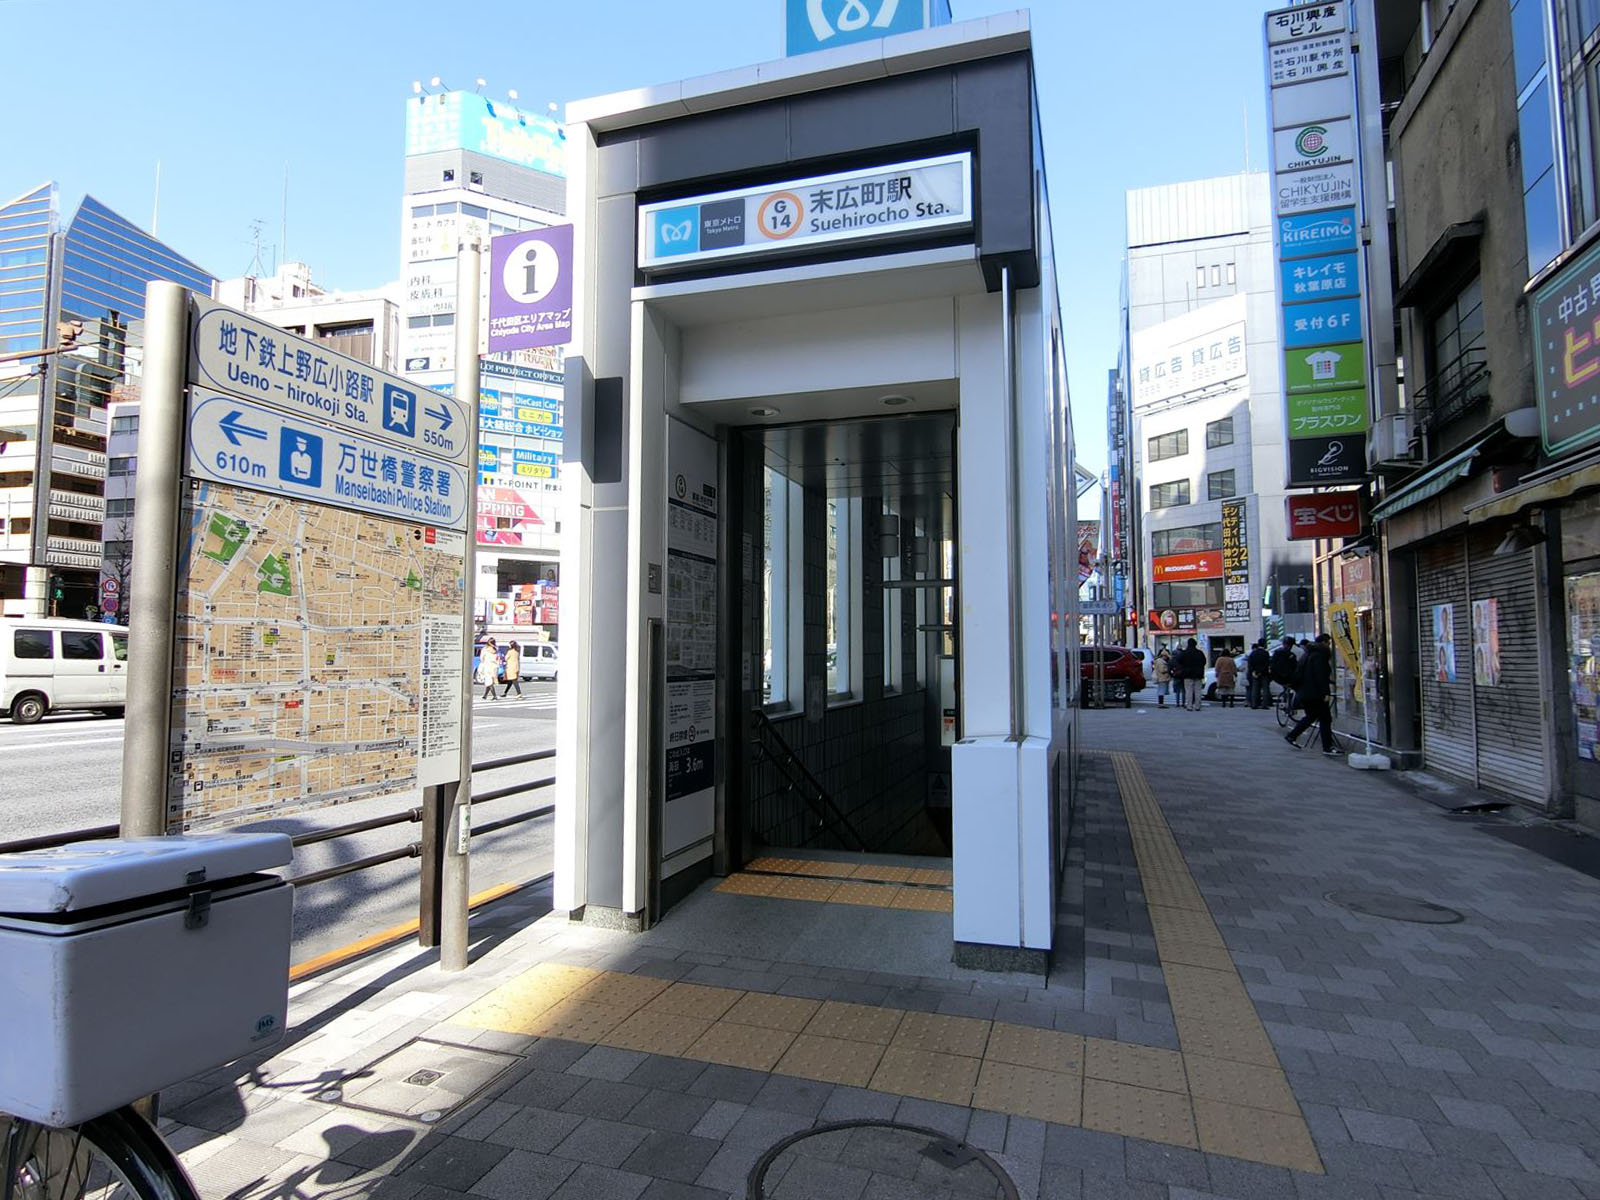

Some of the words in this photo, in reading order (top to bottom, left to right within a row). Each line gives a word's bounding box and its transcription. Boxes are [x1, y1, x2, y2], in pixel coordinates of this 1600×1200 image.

[1275, 5, 1337, 27] 石川興産
[1290, 24, 1323, 37] ビル
[1287, 155, 1341, 169] CHIKYUJIN
[809, 176, 913, 215] 末広町駅
[1279, 179, 1351, 199] CHIKYUJIN
[773, 200, 787, 214] G
[1280, 190, 1351, 208] 留学生支援機構
[704, 215, 742, 228] 東京メトロ
[770, 213, 792, 230] 14
[810, 206, 910, 233] Suehirocho
[916, 201, 951, 218] Sta.
[706, 226, 723, 235] Tokyo
[723, 224, 740, 232] Metro
[1283, 225, 1352, 243] KIREIMO
[1293, 262, 1346, 279] キレイモ
[1294, 278, 1346, 294] 秋葉原店
[490, 308, 572, 329] 千代田区エリアマップ
[490, 327, 519, 338] Chiyoda
[520, 324, 535, 335] City
[536, 322, 554, 331] Area
[555, 320, 571, 330] Map
[219, 320, 374, 405] 地下鉄上野広小路駅
[495, 365, 533, 378] PROJECT
[345, 402, 368, 424] Sta.
[1293, 414, 1362, 430] プラスワン
[423, 430, 454, 451] 550m
[216, 451, 267, 478] 610m
[516, 452, 552, 464] Military
[338, 442, 451, 497] 万世橋警察署
[1310, 465, 1349, 473] BIGVISION
[498, 478, 539, 489] T-POINT
[335, 474, 397, 506] Manseibashi
[397, 488, 423, 511] Police
[424, 495, 452, 518] Station
[477, 488, 496, 500] AN
[1293, 504, 1354, 526] 宝くじ
[1222, 506, 1232, 567] 千代田外神田
[1230, 506, 1240, 567] シティハウス
